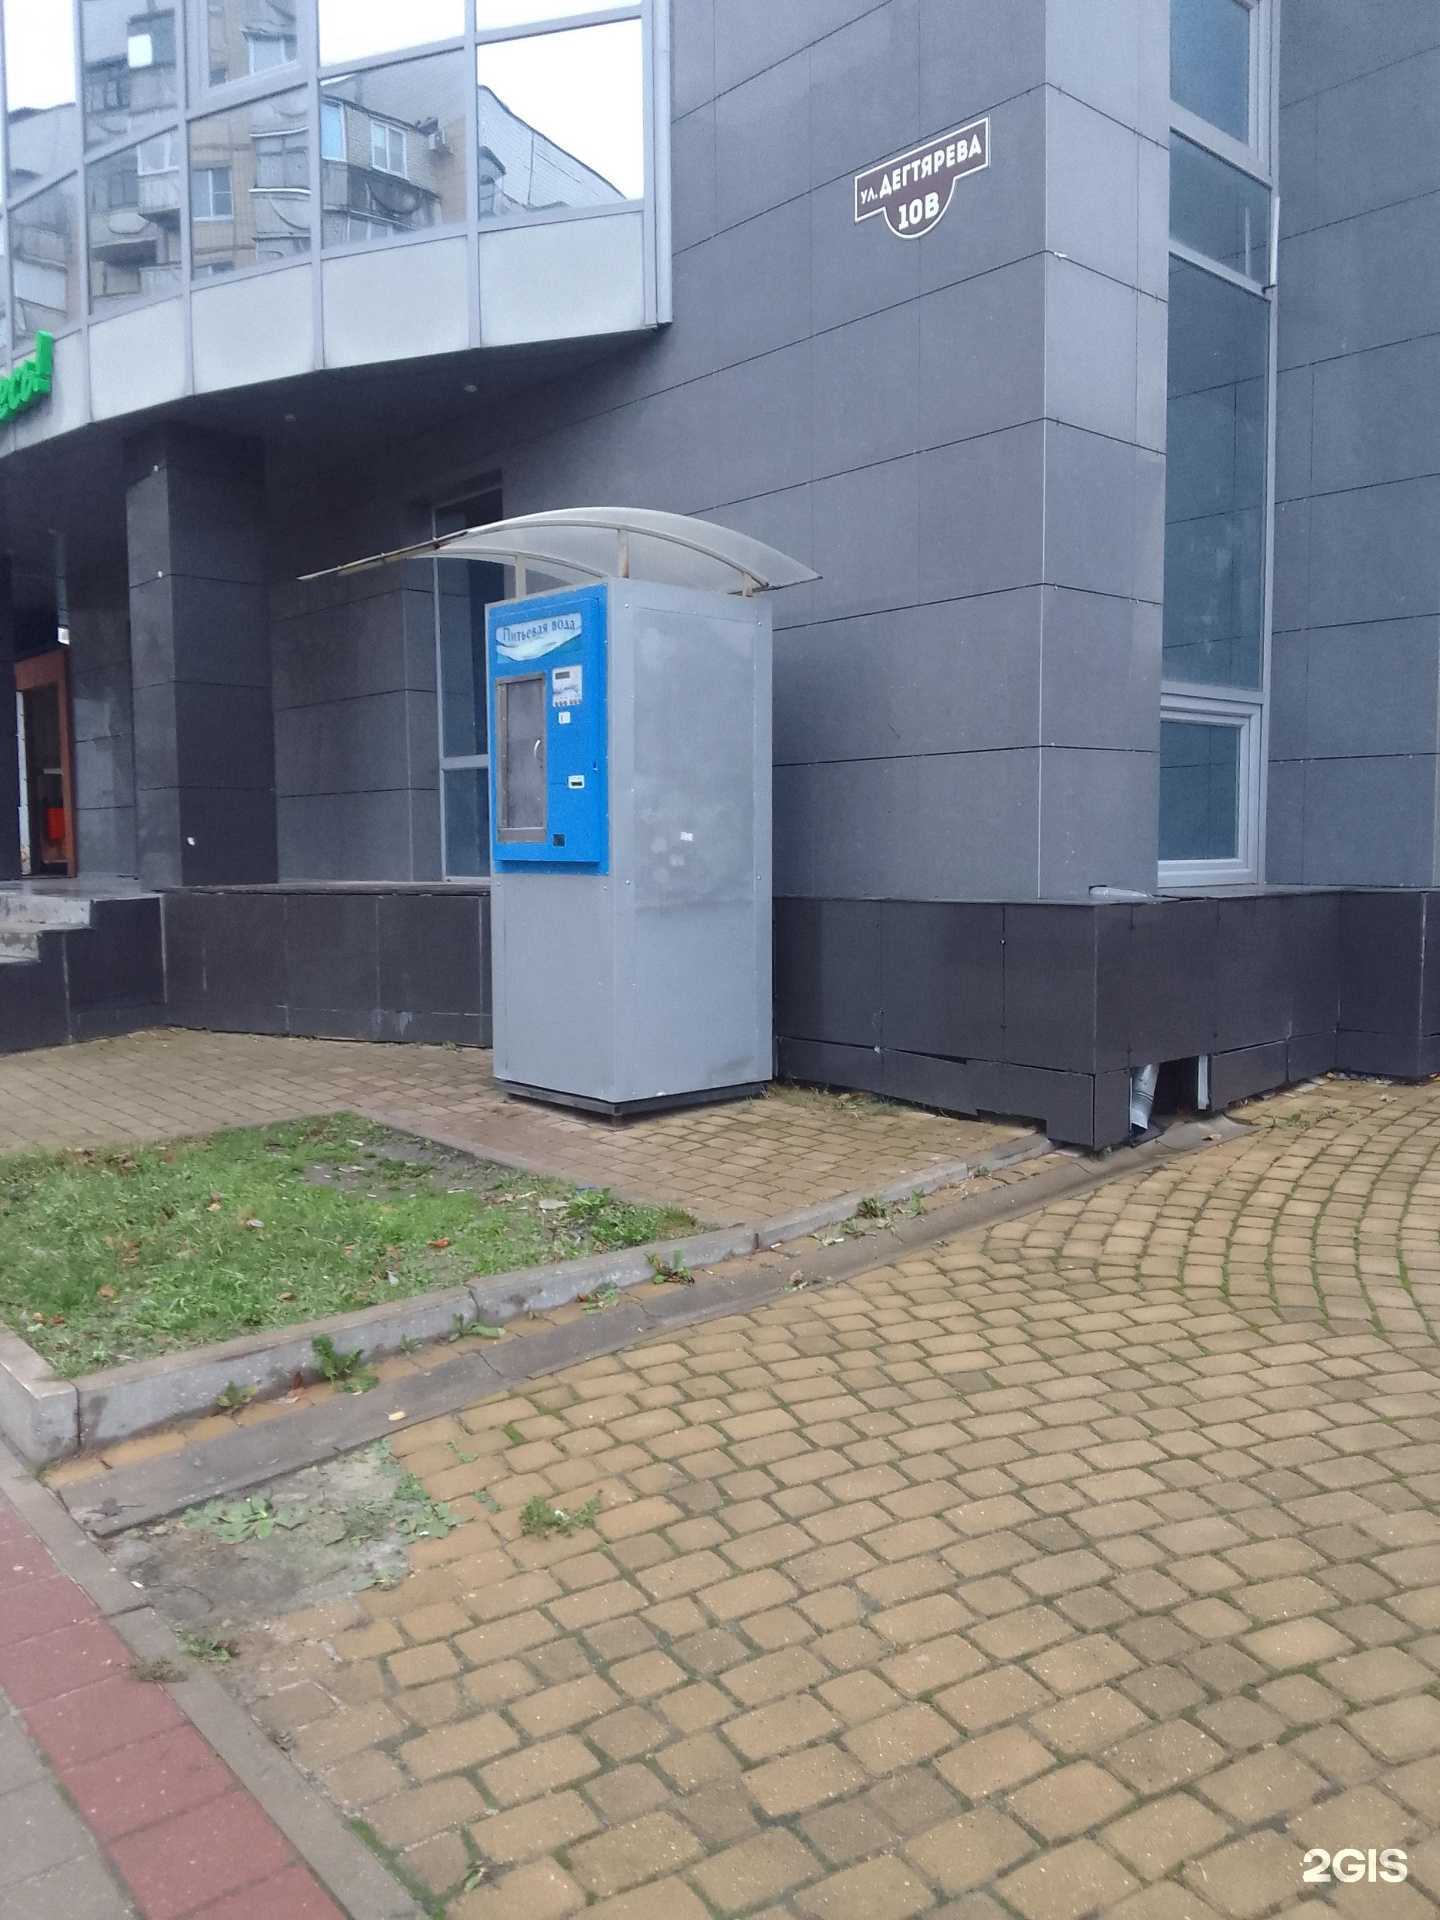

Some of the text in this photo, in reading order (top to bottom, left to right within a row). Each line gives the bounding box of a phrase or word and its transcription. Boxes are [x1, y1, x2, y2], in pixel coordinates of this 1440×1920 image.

[860, 134, 982, 205] ул. ДЕГТЯРЕВА
[898, 192, 940, 230] 10В
[503, 624, 548, 641] Питьевая
